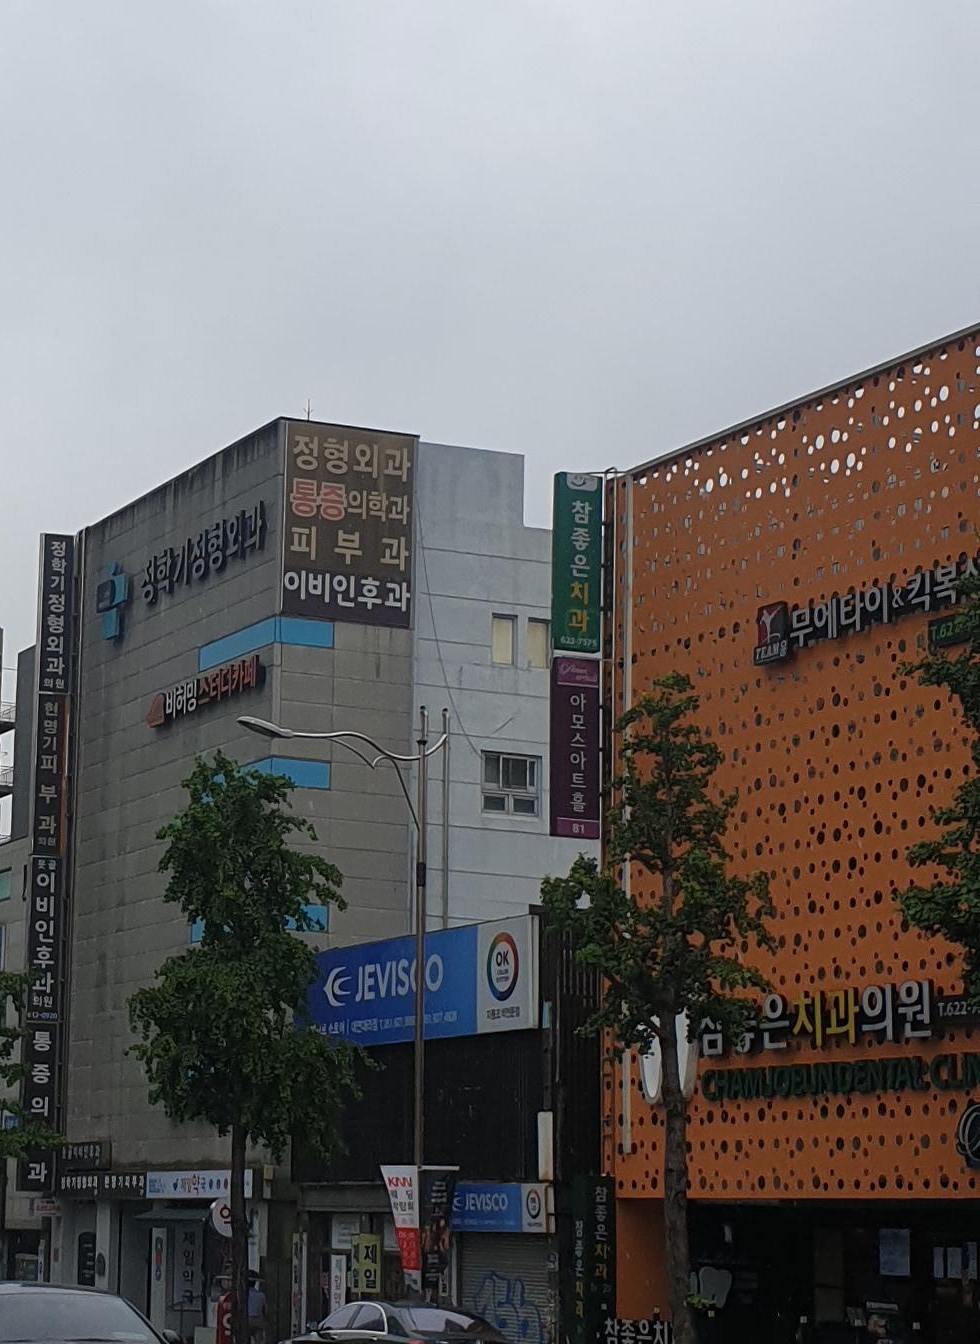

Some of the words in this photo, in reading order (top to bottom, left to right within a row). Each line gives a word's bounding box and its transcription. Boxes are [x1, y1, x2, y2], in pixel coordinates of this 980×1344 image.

[293, 435, 411, 482] 정형외과
[290, 478, 410, 525] 통증의학과
[568, 500, 593, 634] 참좋은치과
[46, 541, 67, 675] 정학기정형외과
[284, 570, 410, 612] 이비인후과
[571, 693, 587, 813] 아모스아트홀
[32, 872, 55, 994] 이비인후과
[355, 954, 444, 1002] JEVISCO
[496, 951, 509, 967] OK
[387, 1176, 412, 1187] KNN
[465, 1192, 509, 1212] JEVISCO
[364, 1243, 377, 1289] 제일
